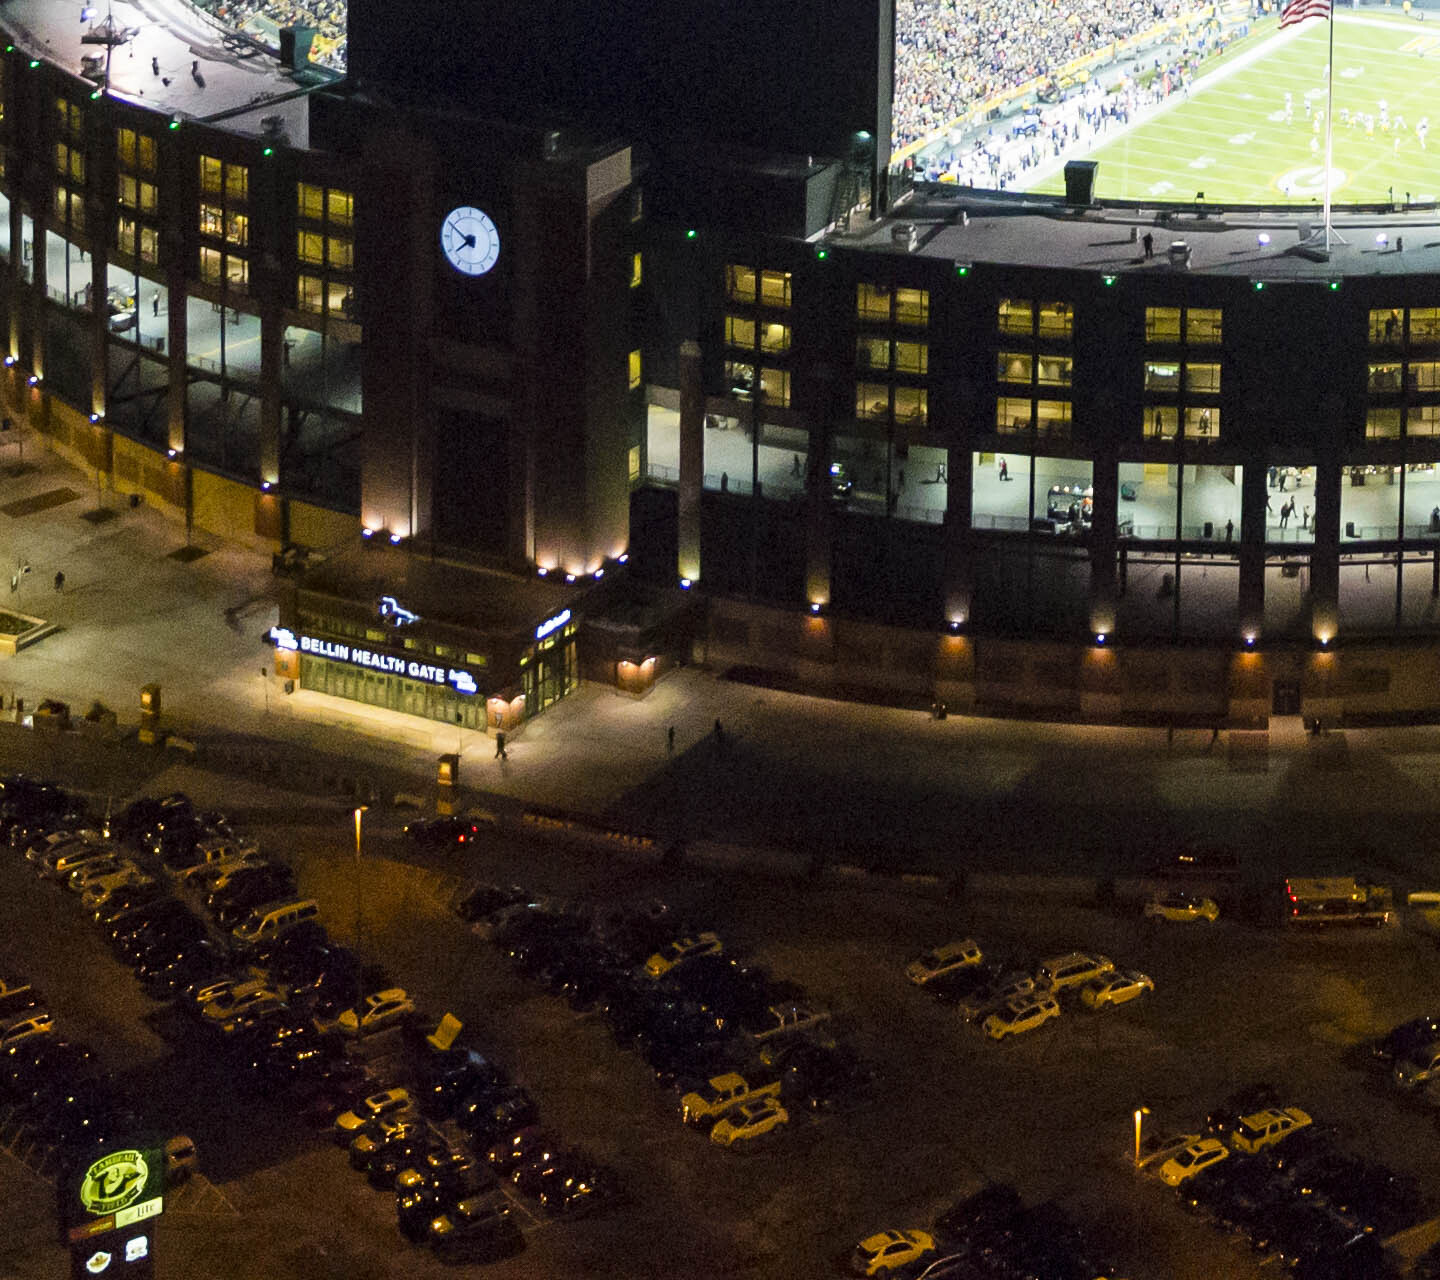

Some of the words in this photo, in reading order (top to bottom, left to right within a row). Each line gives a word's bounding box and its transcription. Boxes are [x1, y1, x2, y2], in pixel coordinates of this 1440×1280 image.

[300, 636, 349, 660] BELLIN
[352, 648, 405, 673] HEALTH
[408, 662, 445, 683] GATE
